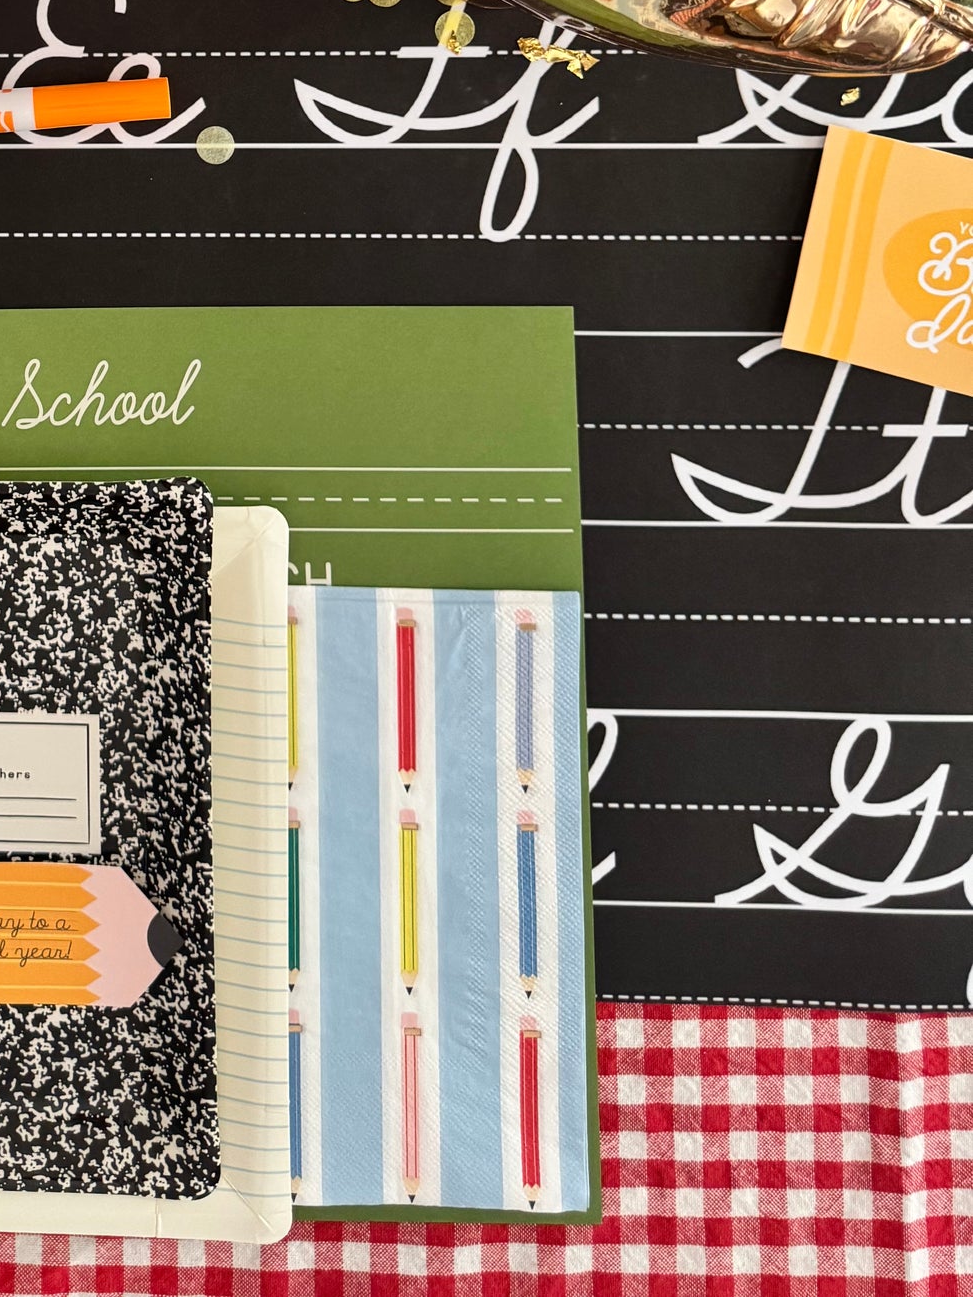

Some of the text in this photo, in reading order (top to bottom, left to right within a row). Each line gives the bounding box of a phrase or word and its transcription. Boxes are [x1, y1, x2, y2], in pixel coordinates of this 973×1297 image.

[1, 358, 202, 430] School
[29, 911, 49, 931] to
[55, 916, 71, 931] a
[15, 940, 73, 968] year!
